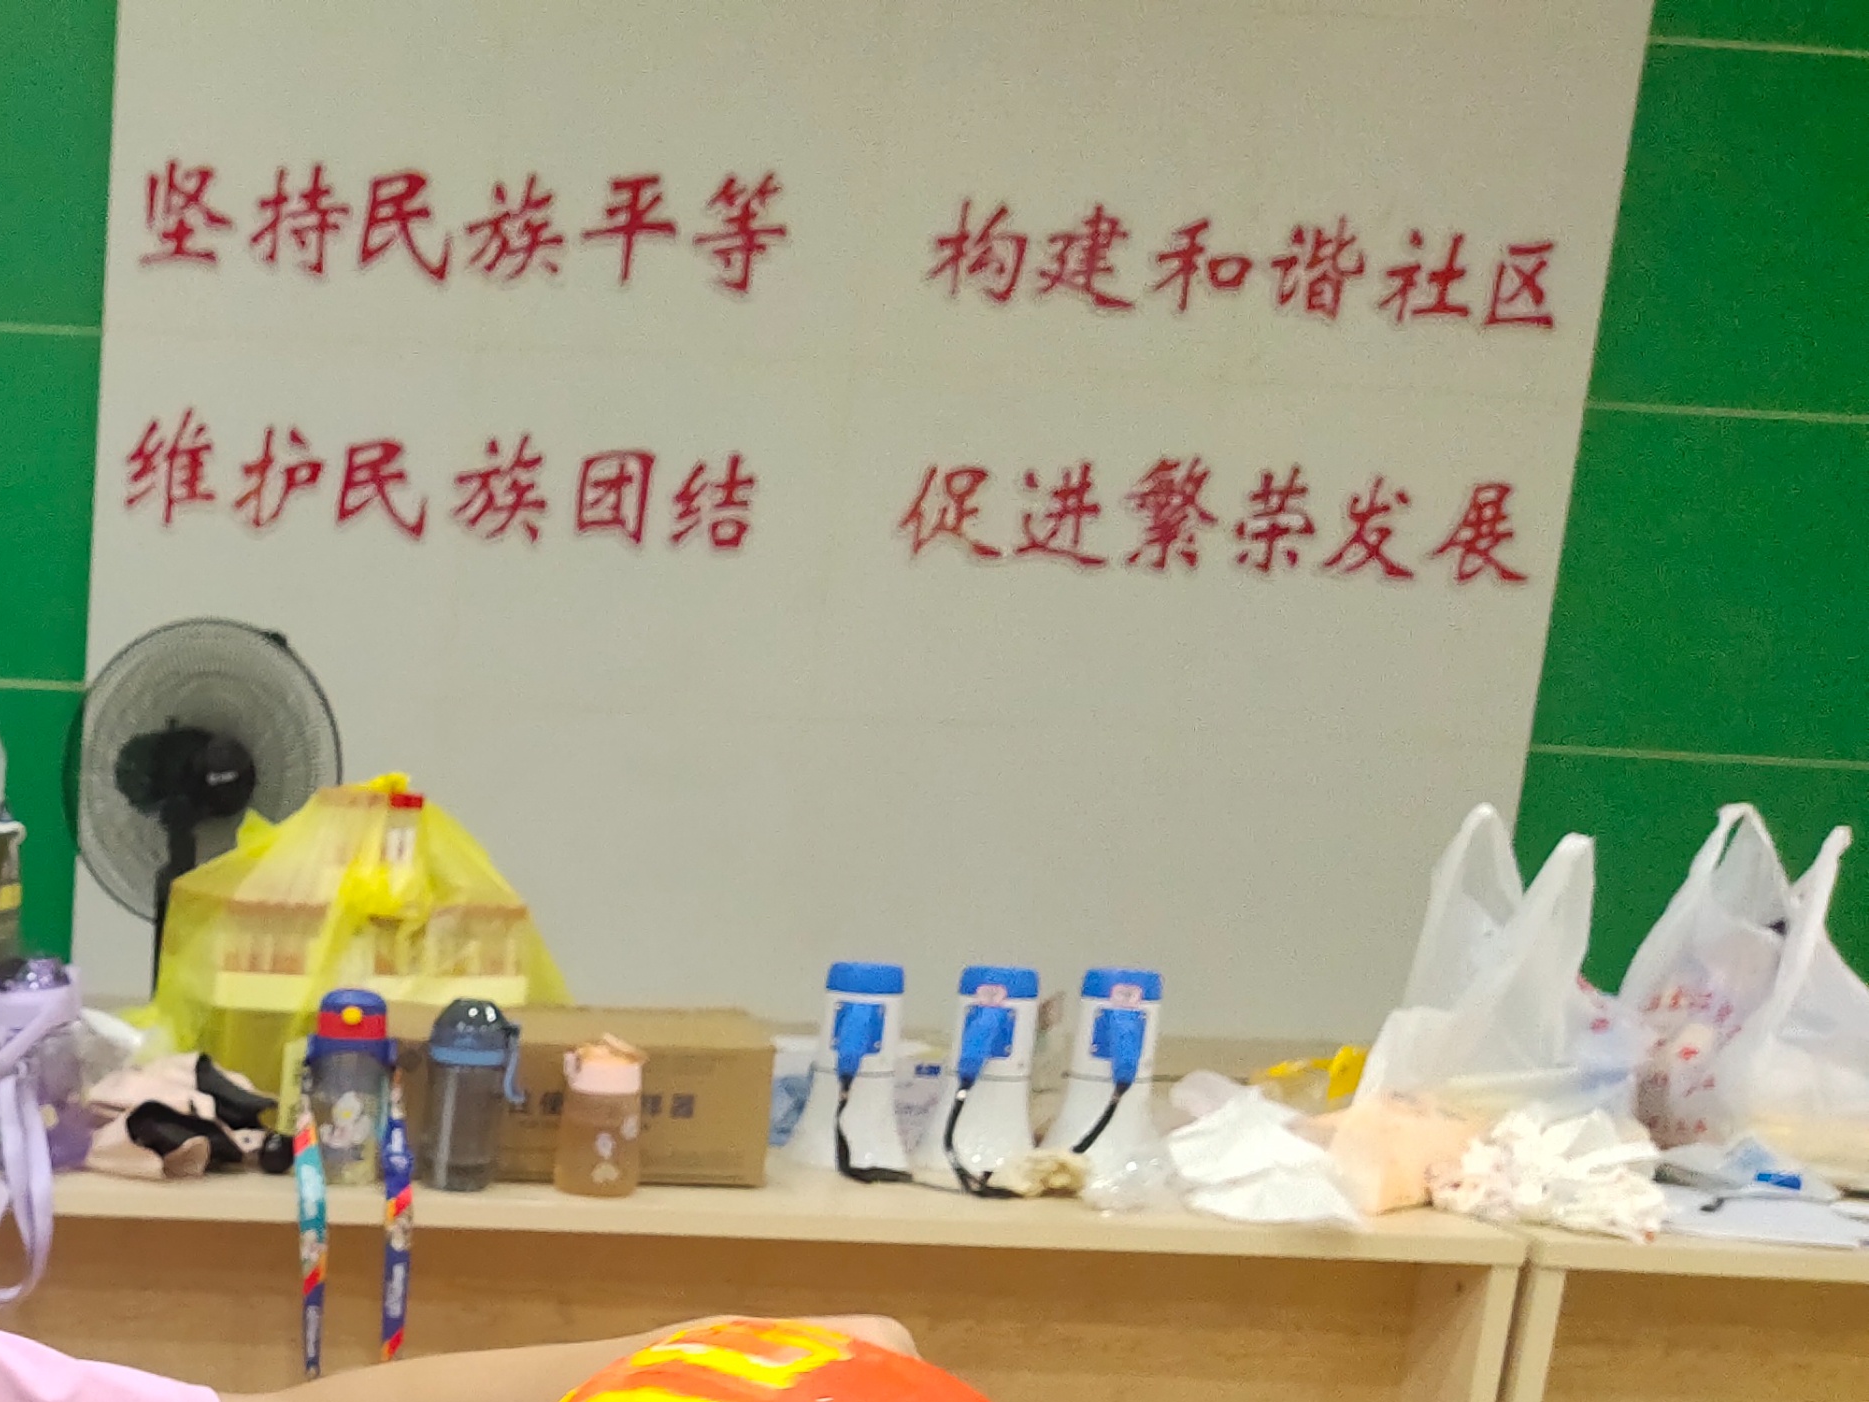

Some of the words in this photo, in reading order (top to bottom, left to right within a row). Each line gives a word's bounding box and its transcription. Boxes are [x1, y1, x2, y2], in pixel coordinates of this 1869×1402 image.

[139, 159, 787, 294] 坚持民族平等
[926, 197, 1556, 329] 构建和谐社区
[124, 406, 758, 550] 维护民族团结
[899, 456, 1528, 584] 促进繁荣发展
